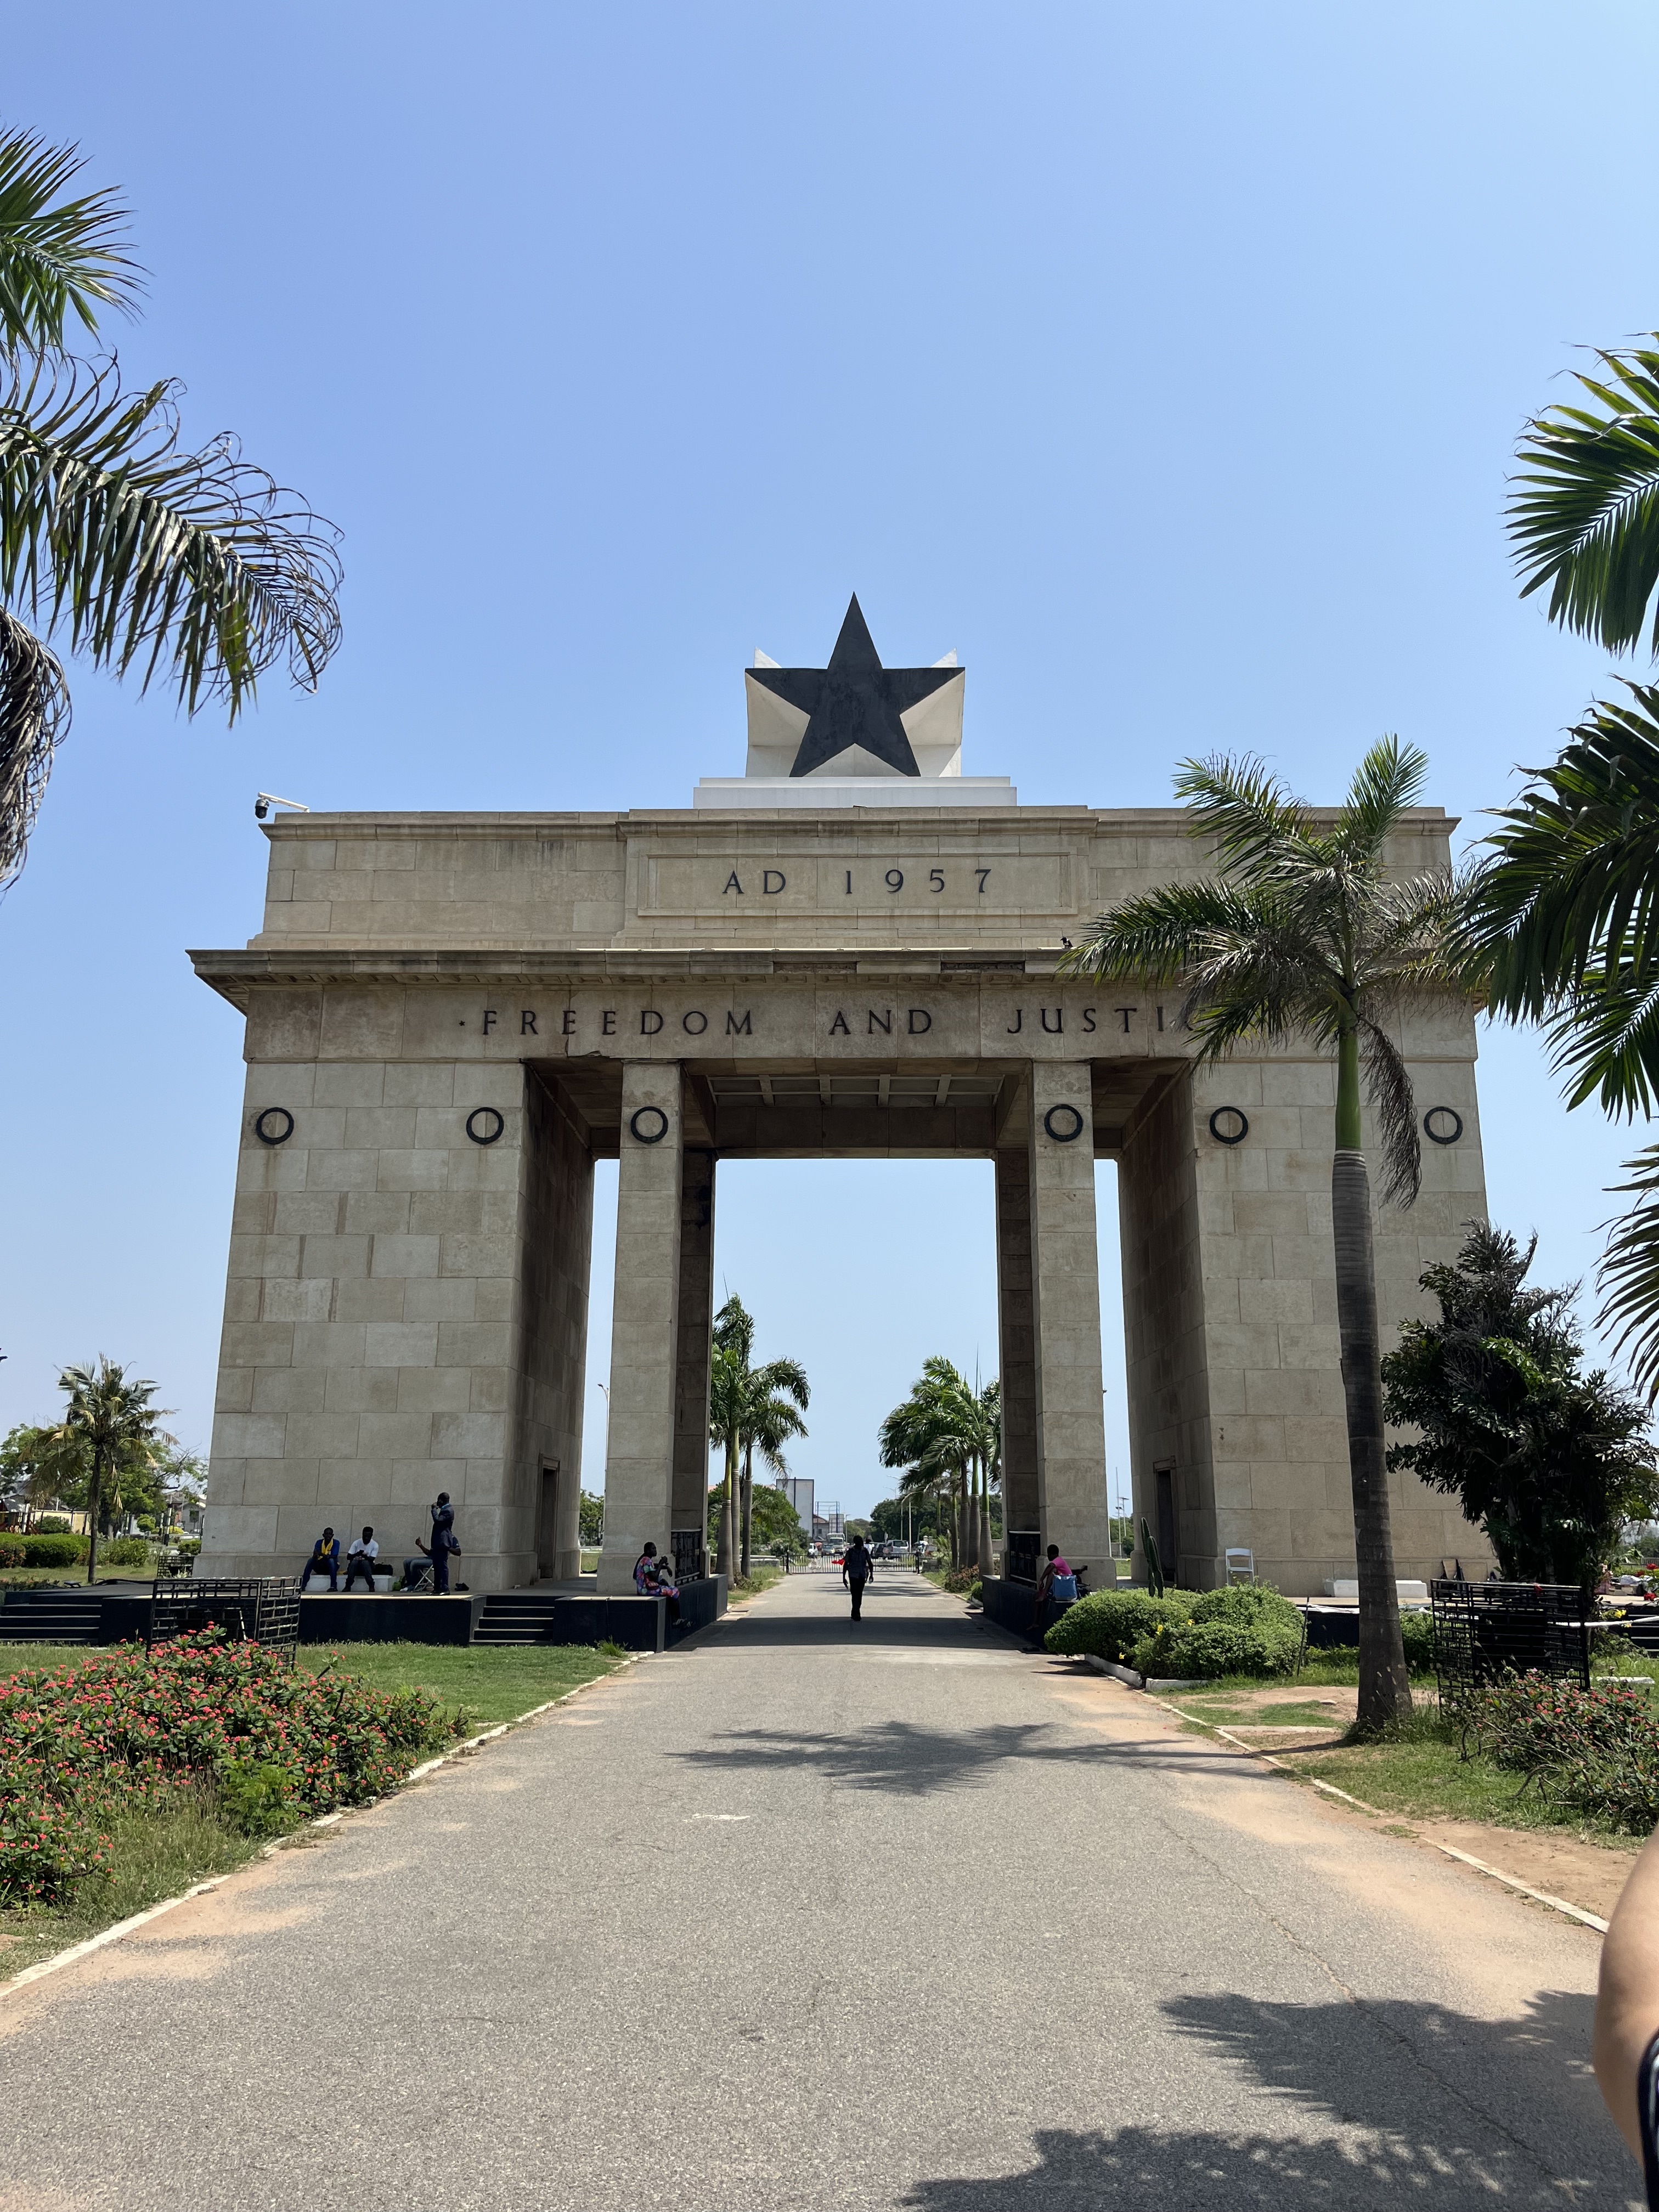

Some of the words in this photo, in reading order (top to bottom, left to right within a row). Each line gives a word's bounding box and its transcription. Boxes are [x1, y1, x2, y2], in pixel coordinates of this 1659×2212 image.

[723, 870, 786, 894] AD
[845, 869, 991, 894] 1957
[482, 1010, 753, 1035] FREEDOM
[829, 1009, 932, 1035] AND
[1007, 1006, 1194, 1034] JUSTI
